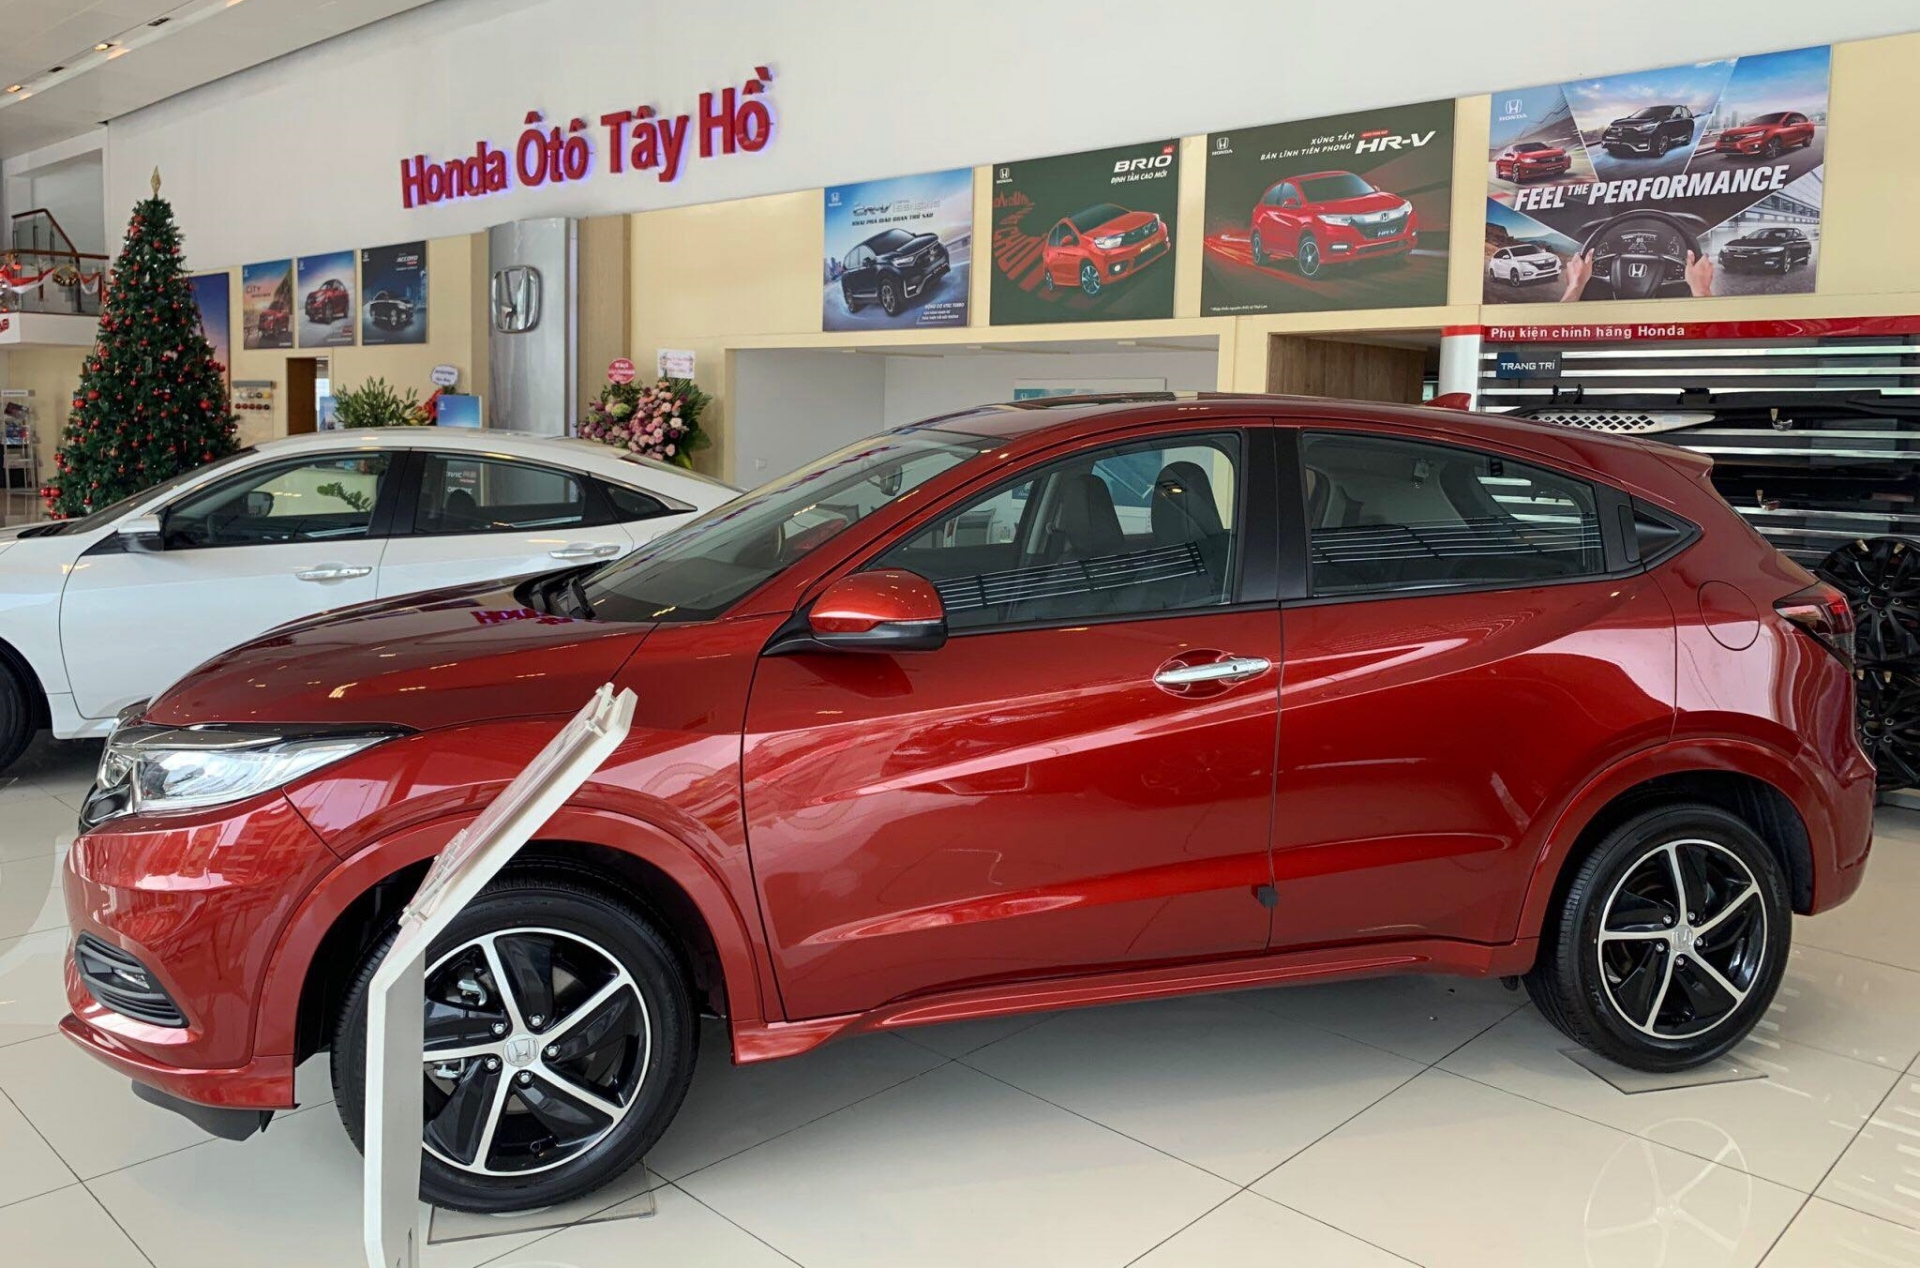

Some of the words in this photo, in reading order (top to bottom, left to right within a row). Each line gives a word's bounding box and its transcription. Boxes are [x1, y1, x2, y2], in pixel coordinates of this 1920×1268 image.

[401, 141, 507, 209] Honda
[516, 110, 590, 187] Ôtô
[600, 105, 690, 183] Tây
[699, 66, 774, 158] Hồ
[1355, 130, 1436, 155] HR-V
[1322, 142, 1352, 153] PHONG
[1113, 155, 1173, 174] BRIO
[1140, 171, 1154, 180] CAO
[1513, 185, 1566, 212] FEEL
[1567, 183, 1589, 196] THE
[1588, 164, 1790, 206] PERFORMANCE
[1491, 328, 1515, 341] Phụ
[1519, 327, 1548, 340] kiện
[1552, 326, 1591, 338] chính
[1596, 325, 1632, 339] hãng
[1638, 325, 1685, 337] Honda
[1501, 362, 1537, 371] TRANG
[1539, 359, 1556, 370] TRÍ
